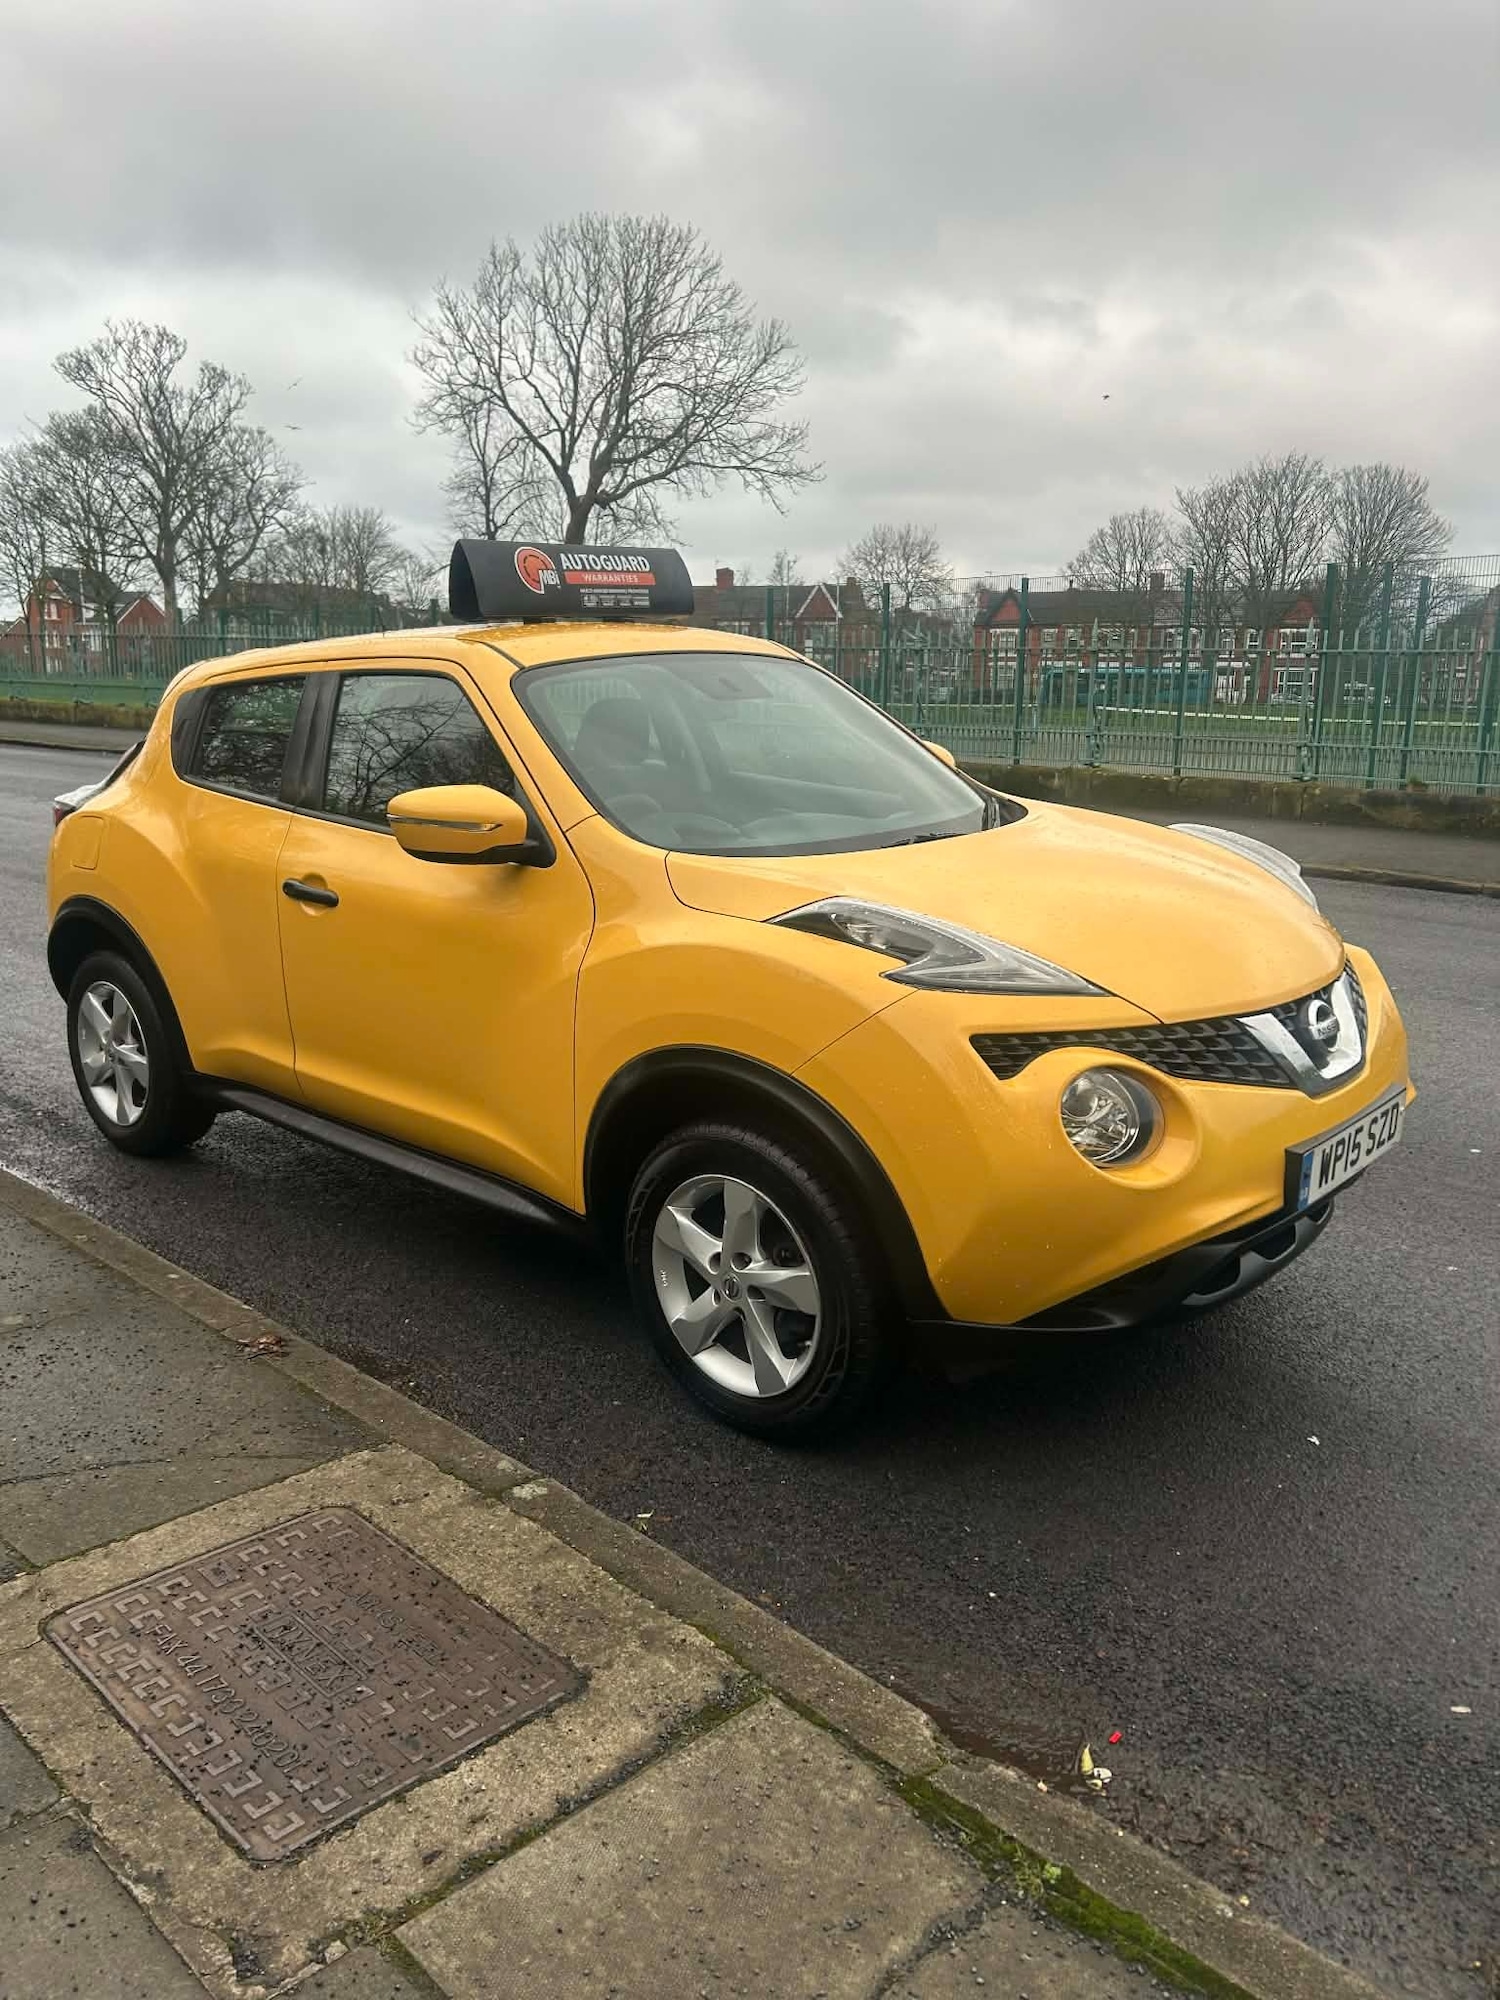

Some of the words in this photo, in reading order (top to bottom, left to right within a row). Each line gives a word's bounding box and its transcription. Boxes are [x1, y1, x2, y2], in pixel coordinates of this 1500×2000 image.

[560, 553, 650, 571] AUTOGUARD
[582, 573, 639, 583] WARRANTIES
[1318, 1126, 1363, 1188] WP15
[1365, 1101, 1399, 1157] SZD
[145, 1622, 188, 1655] FAX
[177, 1653, 208, 1677] 44
